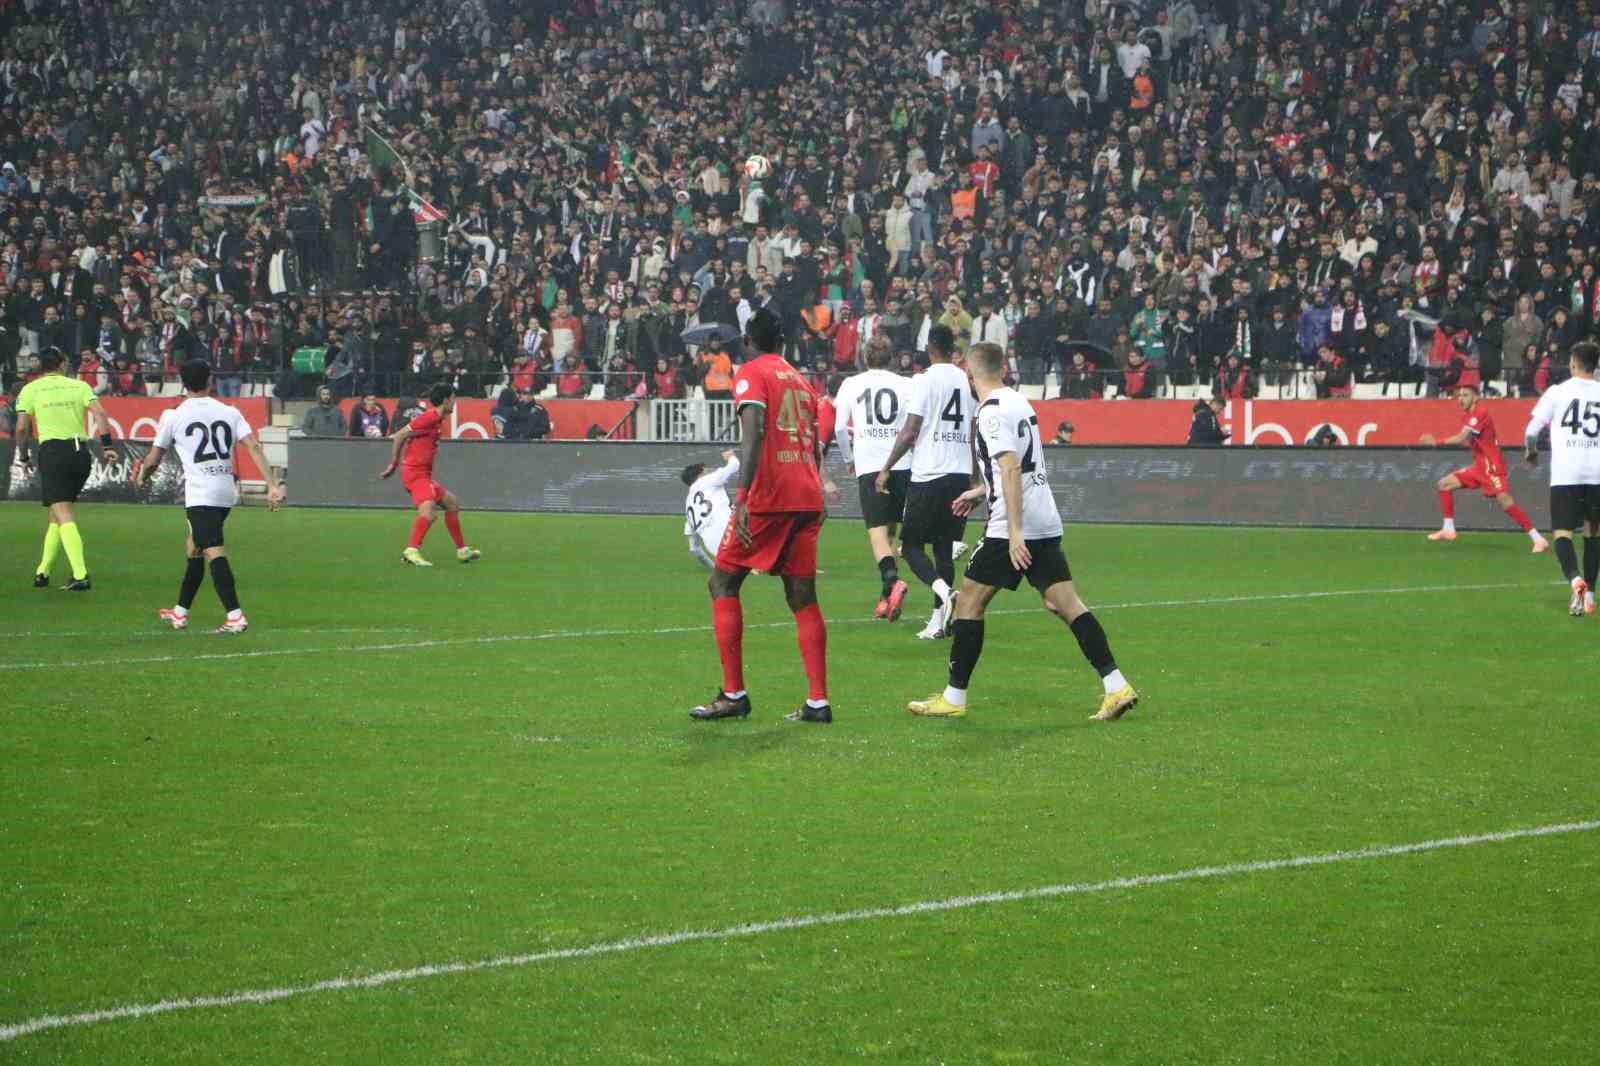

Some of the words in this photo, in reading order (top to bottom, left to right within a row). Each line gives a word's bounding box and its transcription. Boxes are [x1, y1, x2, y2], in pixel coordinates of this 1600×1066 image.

[856, 387, 899, 425] 10
[941, 388, 964, 429] 4
[1560, 398, 1600, 438] 45
[185, 419, 233, 464] 20
[1017, 415, 1044, 474] 2
[687, 490, 713, 532] 23
